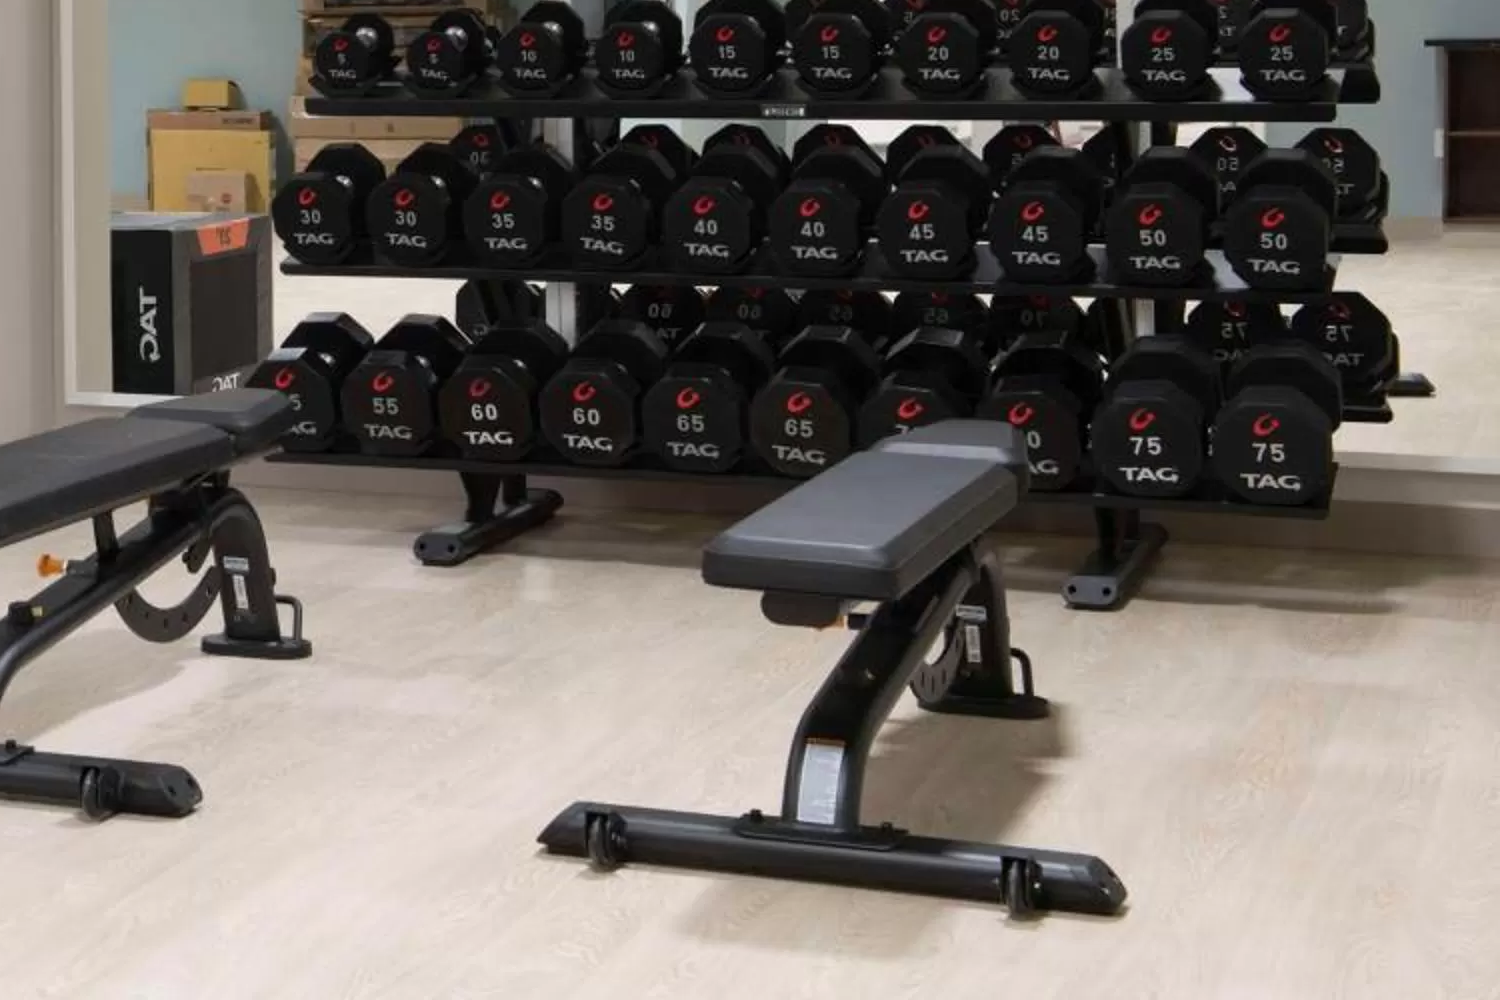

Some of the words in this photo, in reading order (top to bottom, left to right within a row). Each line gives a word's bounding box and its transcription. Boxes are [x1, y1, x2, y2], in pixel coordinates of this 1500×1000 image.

[619, 50, 635, 62] 10
[718, 46, 736, 59] 15
[822, 46, 840, 59] 15
[928, 47, 949, 61] 20
[1037, 46, 1059, 60] 20
[1151, 48, 1175, 61] 25
[1270, 46, 1294, 61] 25
[328, 69, 357, 79] TAG
[420, 68, 450, 81] TAG
[513, 68, 547, 79] TAG
[611, 68, 645, 79] TAG
[708, 67, 748, 79] TAG
[812, 67, 852, 79] TAG
[918, 68, 960, 80] TAG
[1027, 67, 1070, 80] TAG
[1142, 70, 1187, 81] TAG
[1260, 69, 1307, 81] TAG
[300, 210, 321, 224] 30
[396, 211, 416, 226] 30
[492, 213, 515, 229] 35
[591, 215, 615, 231] 35
[693, 220, 717, 235] 40
[801, 222, 825, 237] 40
[909, 224, 935, 240] 45
[1022, 226, 1048, 242] 45
[294, 233, 335, 245] TAG
[385, 233, 427, 247] TAG
[484, 237, 527, 249] TAG
[1139, 230, 1167, 245] 50
[1260, 233, 1287, 249] 50
[580, 237, 624, 254] TAG
[683, 243, 730, 257] TAG
[791, 246, 837, 259] TAG
[901, 250, 949, 263] TAG
[1012, 251, 1061, 265] TAG
[1129, 256, 1181, 269] TAG
[1247, 259, 1300, 274] TAG
[373, 397, 399, 415] 55
[471, 403, 498, 420] 60
[573, 408, 601, 425] 60
[676, 414, 705, 432] 65
[364, 423, 412, 440] TAG
[784, 419, 813, 437] 65
[463, 431, 515, 445] TAG
[563, 433, 613, 451] TAG
[667, 441, 720, 459] TAG
[1129, 437, 1161, 455] 75
[1252, 443, 1285, 463] 75
[772, 445, 826, 465] TAG
[1119, 467, 1179, 483] TAG
[1240, 473, 1301, 491] TAG
